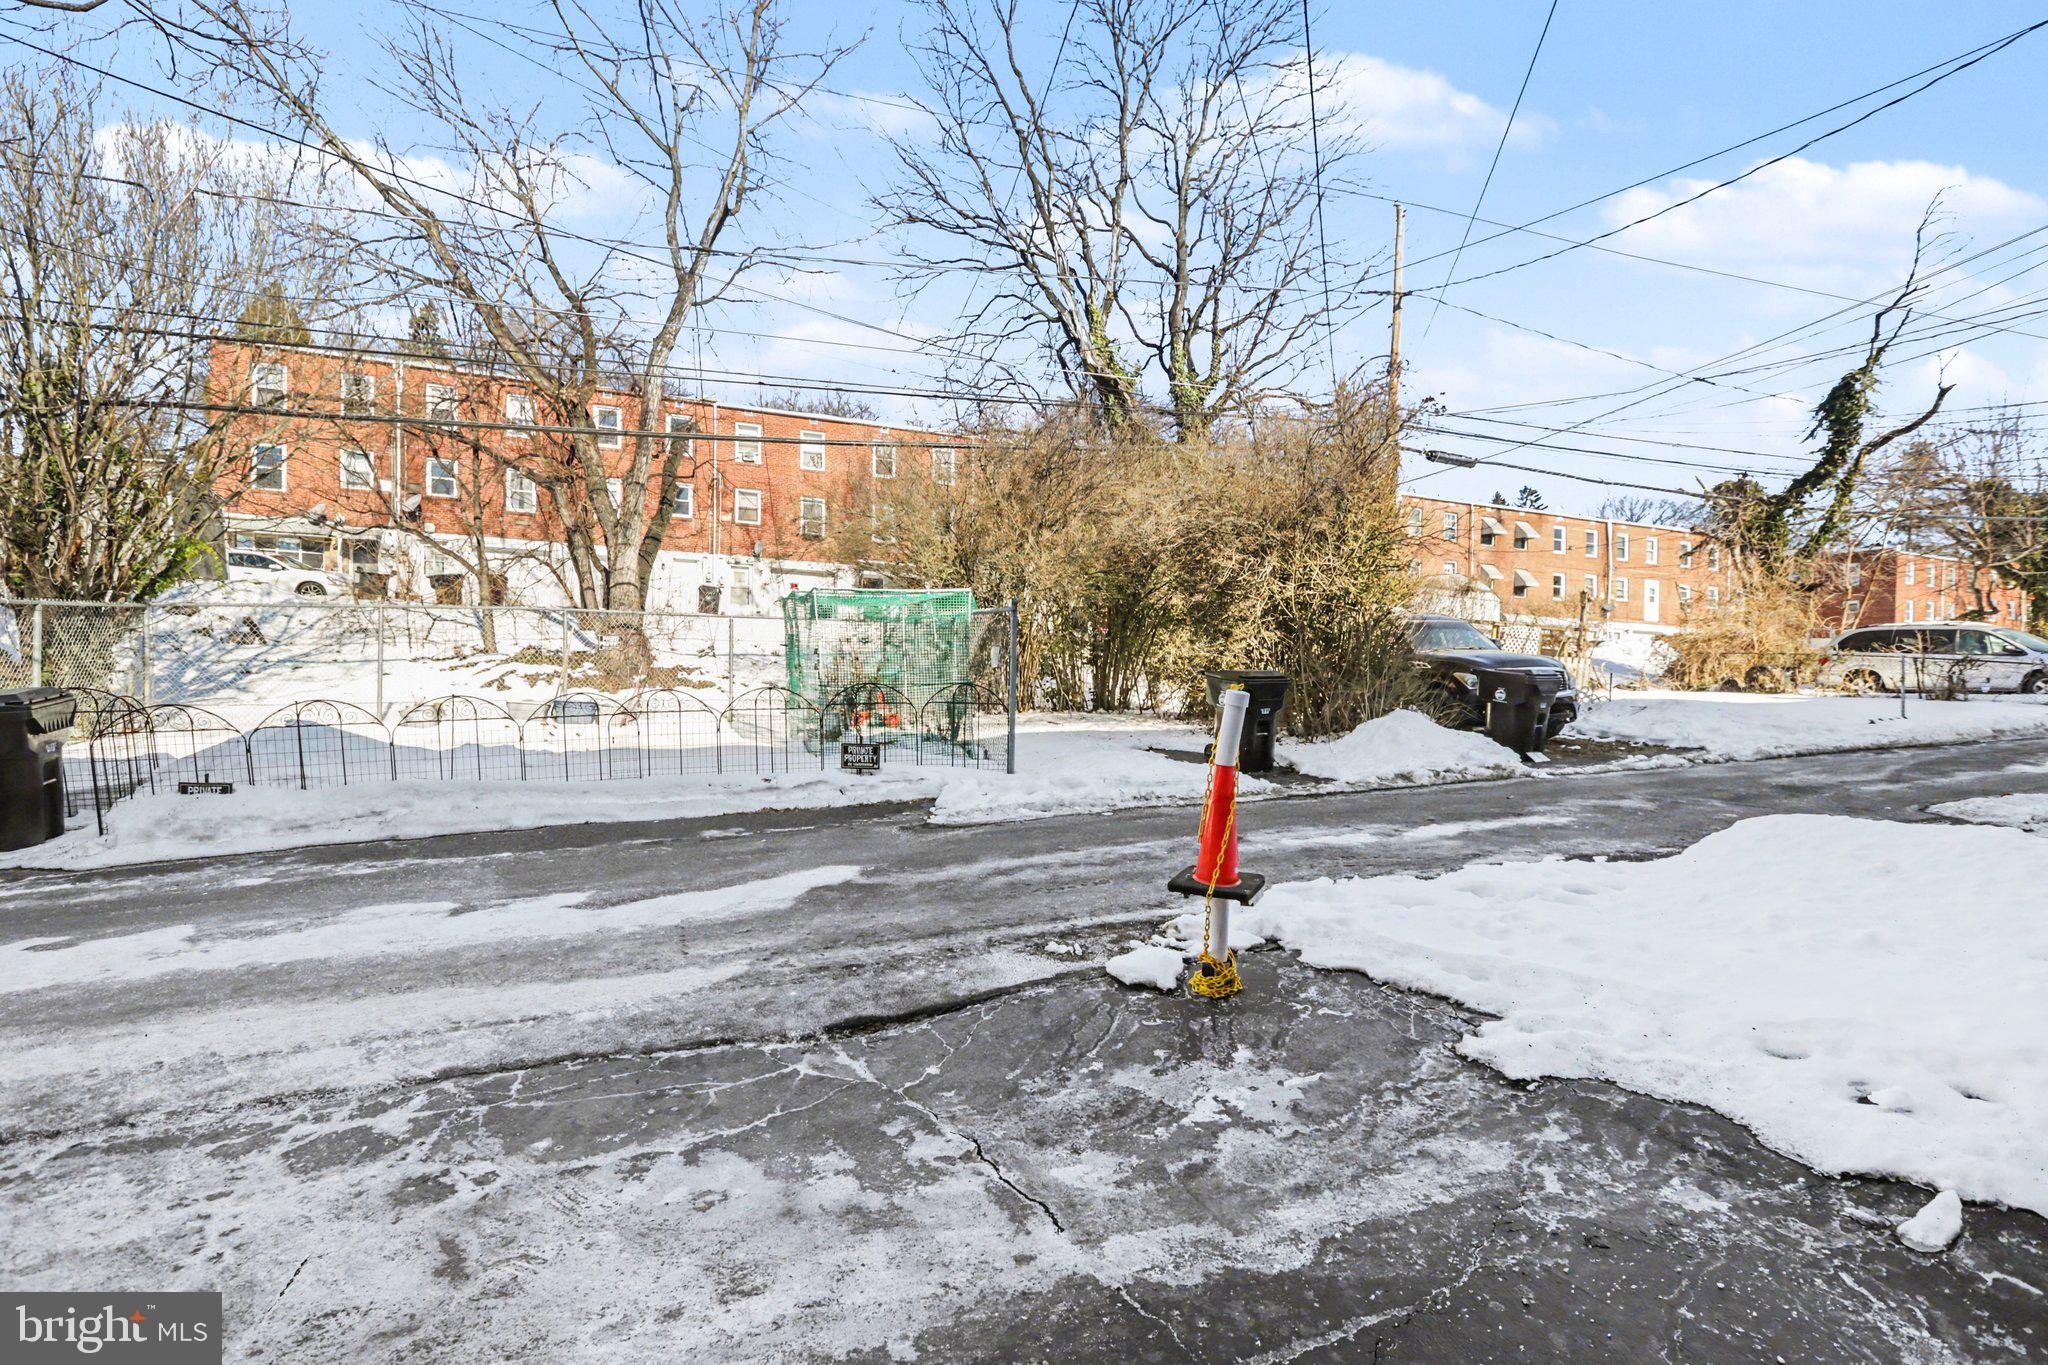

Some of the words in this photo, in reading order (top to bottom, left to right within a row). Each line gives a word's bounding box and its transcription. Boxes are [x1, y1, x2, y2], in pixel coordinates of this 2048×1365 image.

[848, 746, 873, 754] PRIVATE
[844, 754, 877, 762] PROPERTY
[187, 786, 222, 794] PRIVATE
